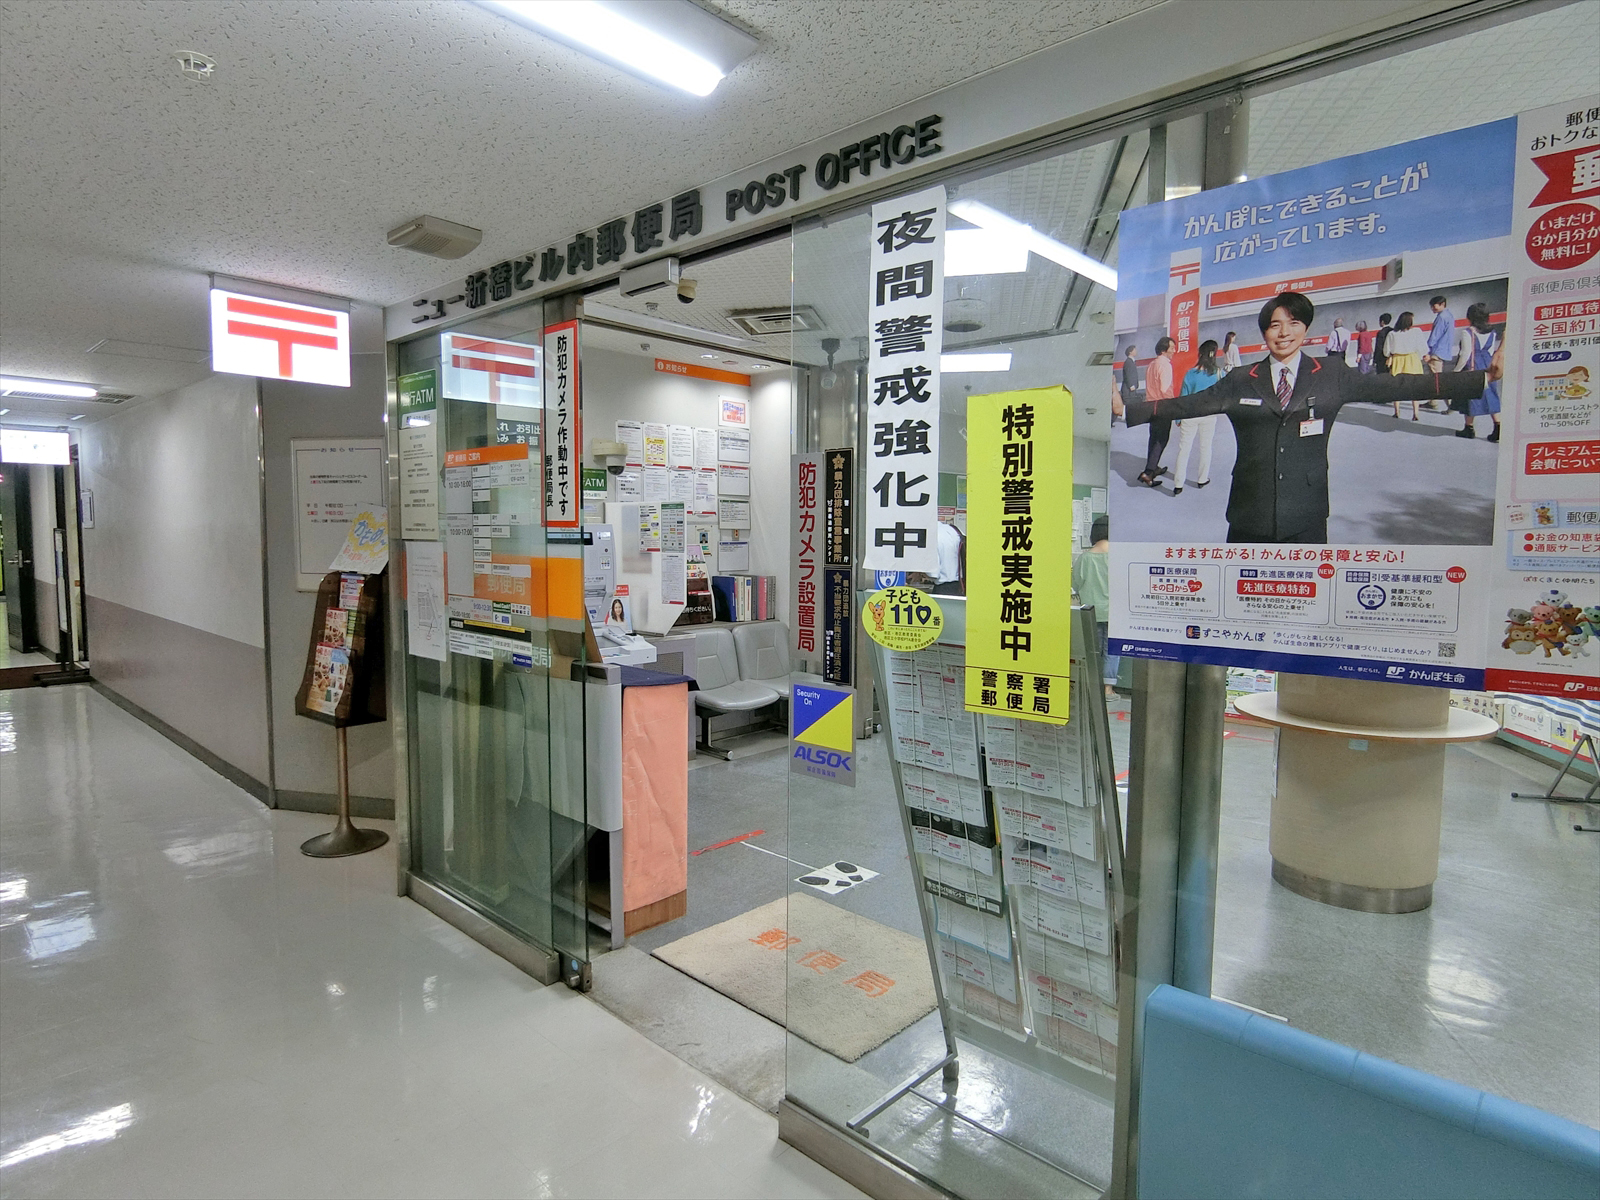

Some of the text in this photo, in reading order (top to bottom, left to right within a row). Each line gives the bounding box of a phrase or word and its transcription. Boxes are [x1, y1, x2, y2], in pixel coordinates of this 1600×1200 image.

[725, 114, 942, 221] POST OFFICE
[1184, 161, 1430, 240] かんぽにできることが
[1539, 210, 1597, 231] いまだけ
[1213, 212, 1387, 264] 広がっています。
[1540, 301, 1599, 319] 割引優待
[1177, 316, 1190, 353] 郵便局
[1533, 318, 1600, 337] 全国約1
[1539, 353, 1563, 361] グルメ
[665, 363, 687, 374] お知らせ
[873, 207, 937, 558] 夜間警戒強化中
[557, 334, 568, 516] 防犯カメラ作動中です
[582, 478, 605, 488] ATM
[1566, 511, 1600, 524] 郵便
[1000, 403, 1035, 661] 特別警戒実施中
[798, 461, 817, 652] 防犯カメラ設置局
[1166, 568, 1198, 576] 医療保障
[1259, 570, 1314, 579] 先進医療保障
[1371, 573, 1443, 584] 引受基準緩和型
[1447, 571, 1465, 579] NEW
[885, 589, 921, 604] 子ども
[1243, 582, 1310, 595] 先進医療特約
[1391, 588, 1433, 596] 健康に不安の
[981, 670, 1050, 694] 警察署
[1408, 669, 1466, 684] かんぽ生命
[796, 688, 821, 700] Security
[803, 697, 813, 706] On
[981, 689, 1050, 714] 郵便局
[793, 745, 852, 772] ALSOK
[748, 927, 897, 998] 郵便局
